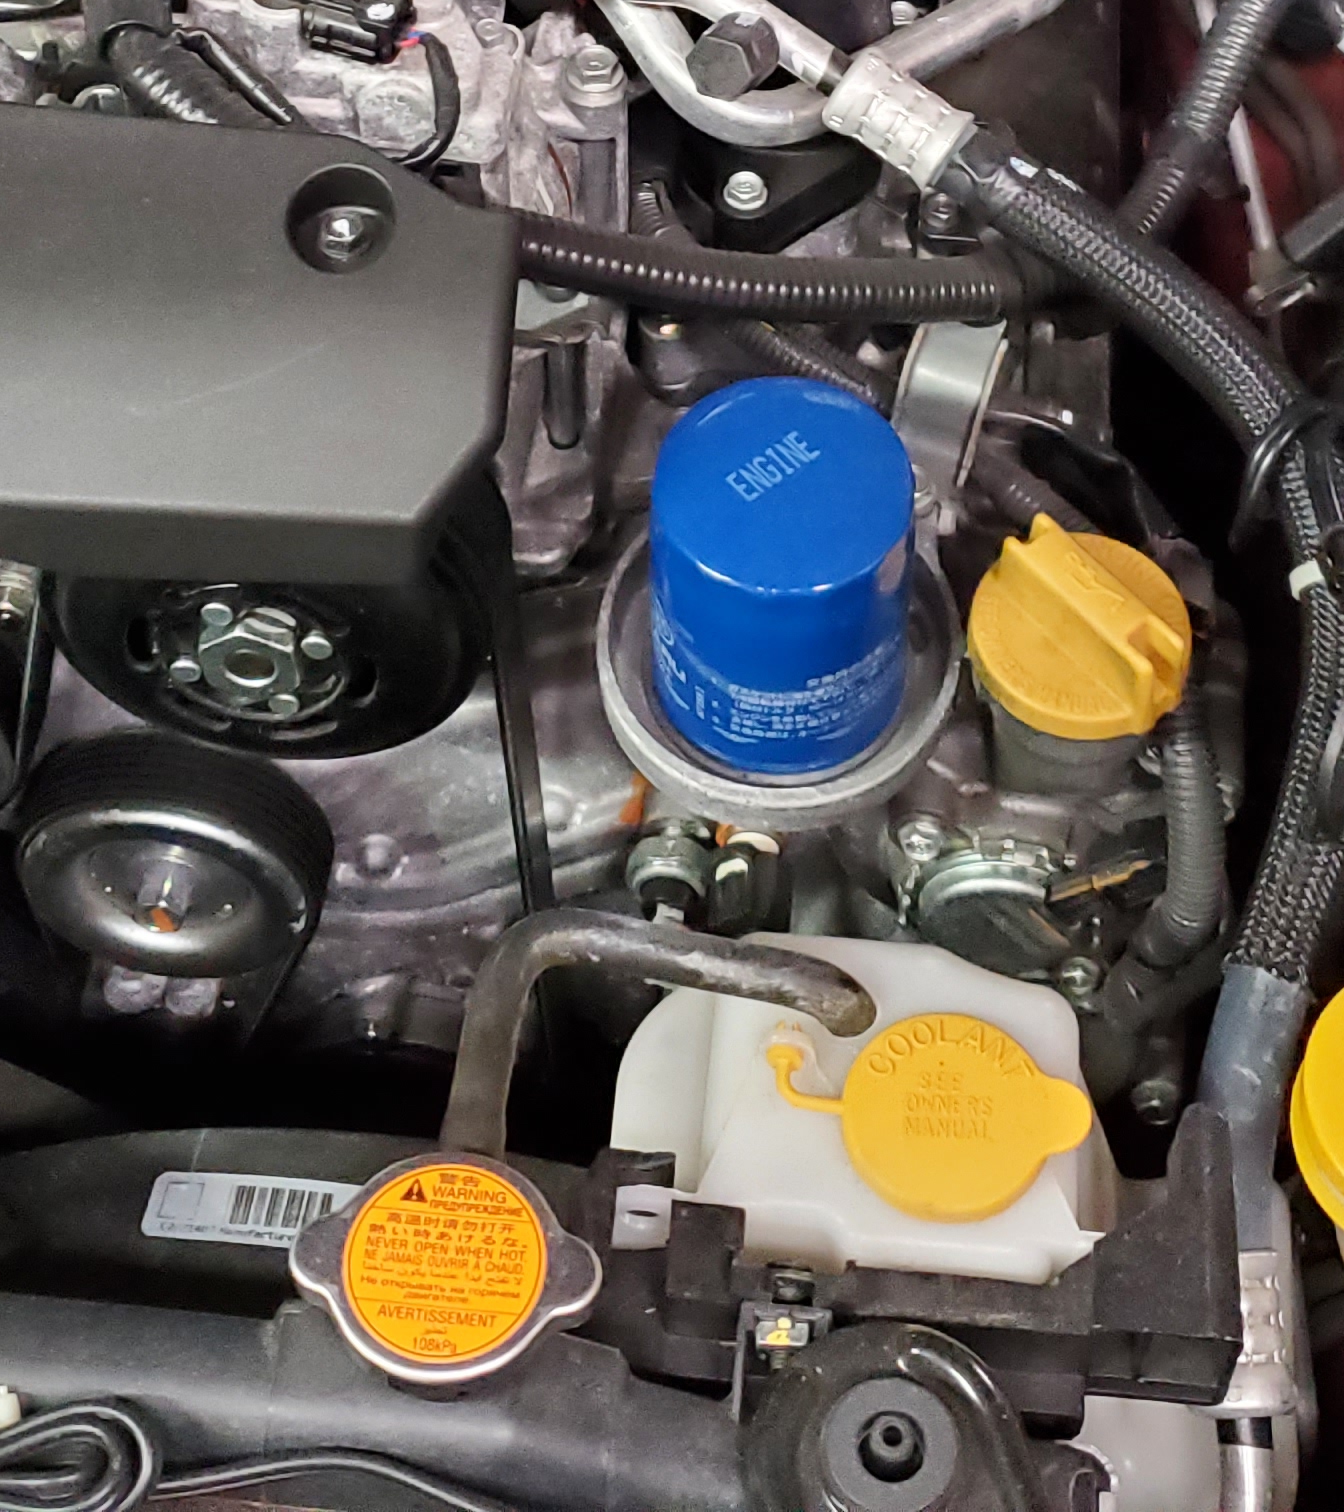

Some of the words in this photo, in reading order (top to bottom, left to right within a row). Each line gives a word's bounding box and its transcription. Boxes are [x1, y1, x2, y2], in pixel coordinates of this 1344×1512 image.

[725, 430, 821, 503] ENGINE
[868, 1020, 1037, 1078] COOLANT
[920, 1072, 962, 1093] SEE
[904, 1116, 991, 1139] MANUAL
[432, 1186, 507, 1204] WARNING
[364, 1248, 376, 1259] NE
[383, 1251, 422, 1265] JAMAIS
[427, 1255, 469, 1269] OUVRIR
[366, 1236, 408, 1251] NEVER
[414, 1241, 449, 1255] OPEN
[456, 1246, 493, 1259] WHEN
[377, 1304, 497, 1328] AVERTISSEMENT
